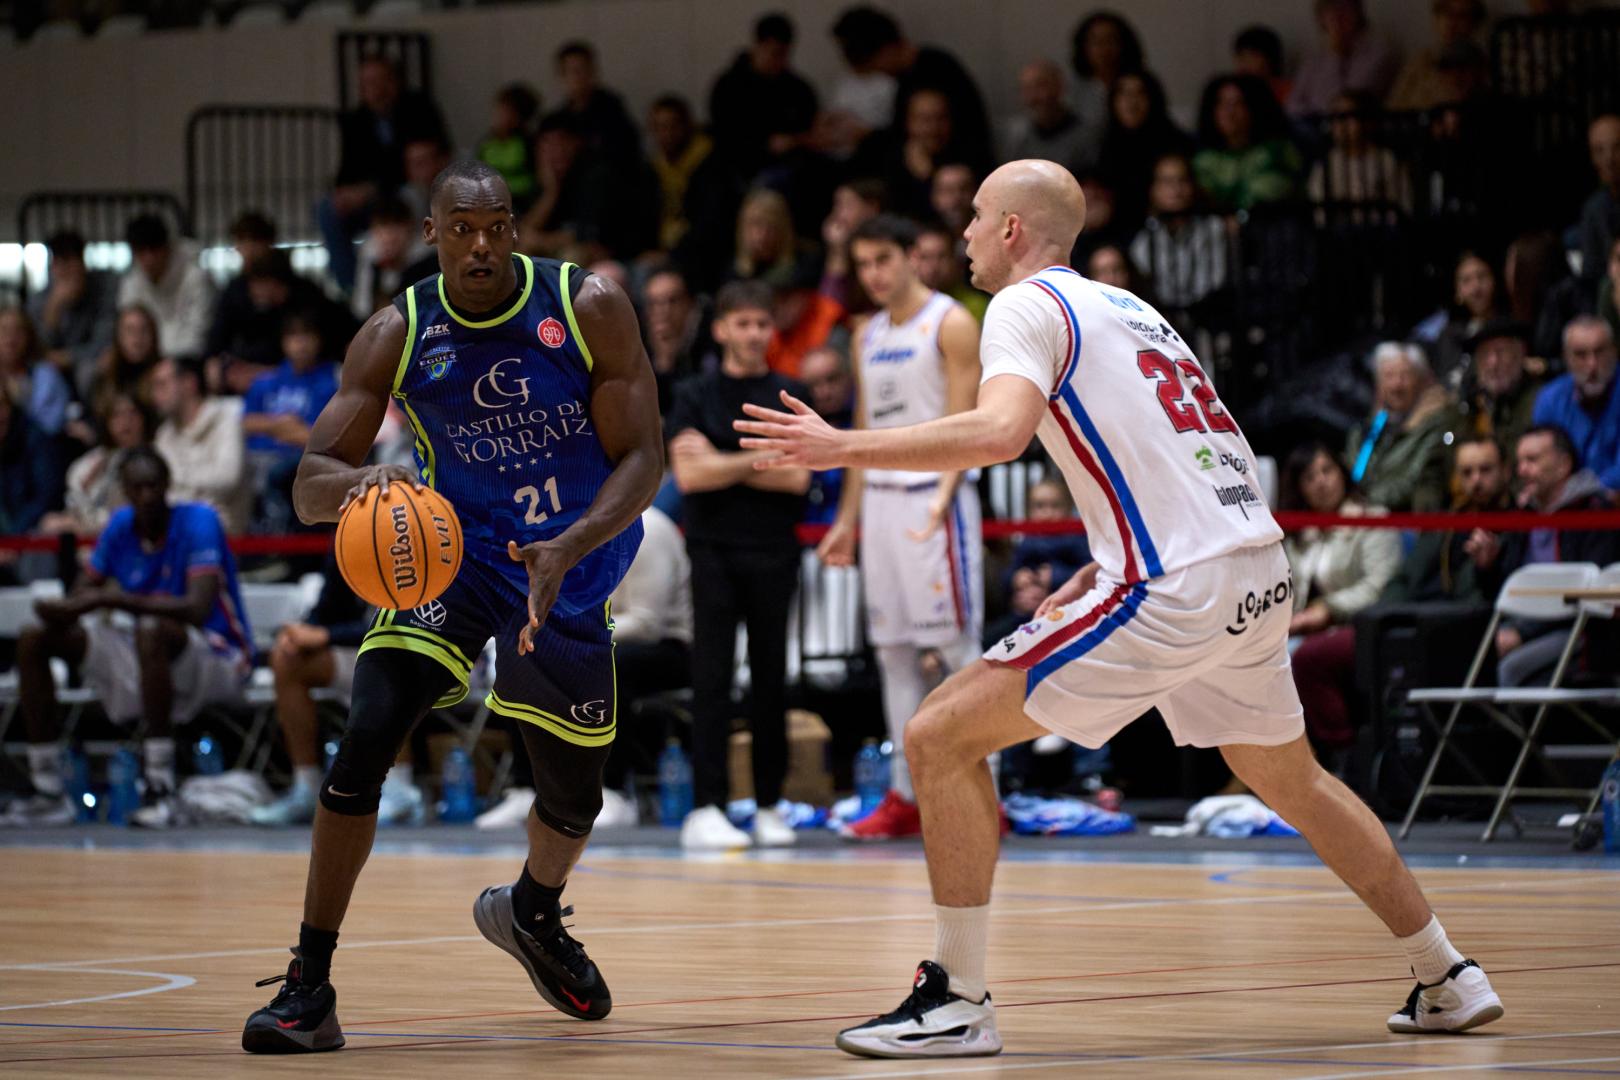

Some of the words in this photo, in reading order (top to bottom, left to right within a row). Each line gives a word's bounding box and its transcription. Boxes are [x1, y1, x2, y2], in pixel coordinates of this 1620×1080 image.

[1137, 349, 1239, 436] 22
[514, 476, 562, 525] 21
[390, 504, 418, 590] Wilson
